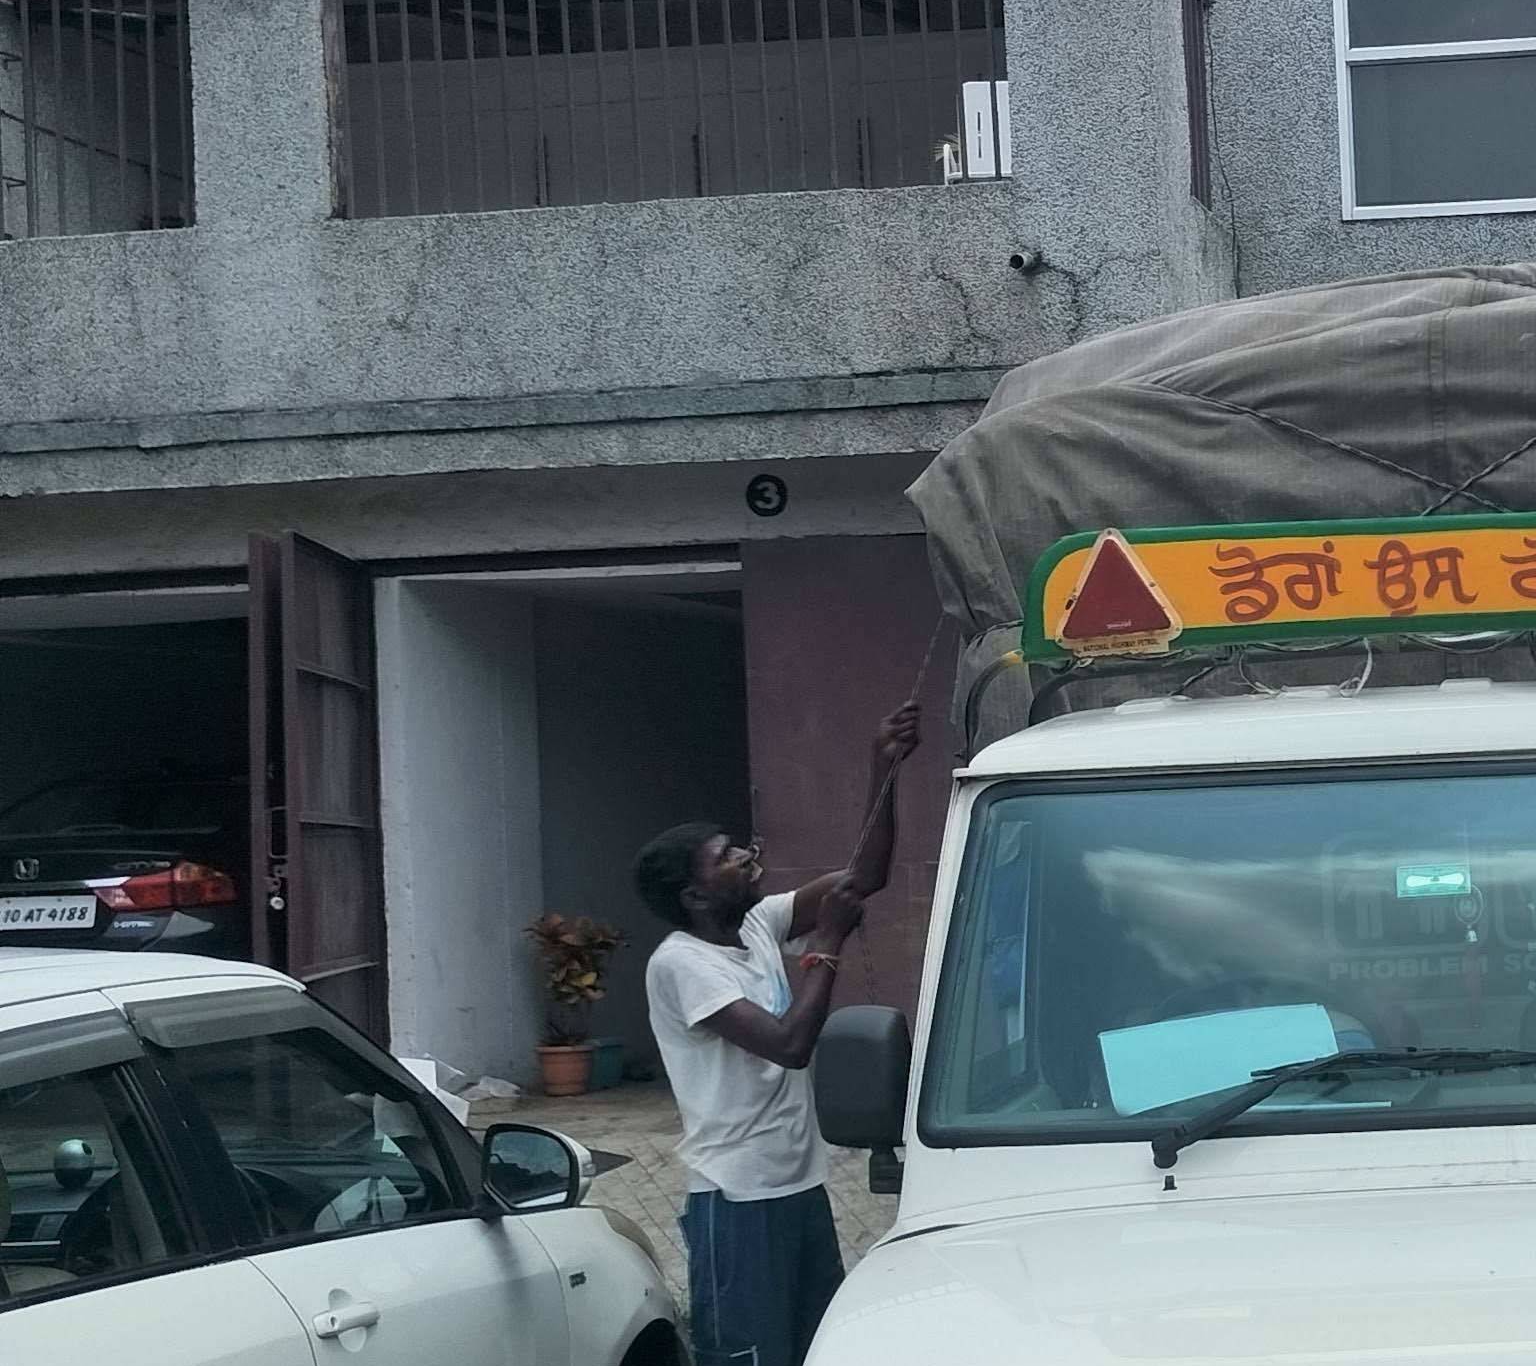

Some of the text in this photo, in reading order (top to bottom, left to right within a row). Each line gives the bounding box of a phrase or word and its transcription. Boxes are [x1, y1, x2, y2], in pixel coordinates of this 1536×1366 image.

[755, 481, 781, 510] 3
[4, 906, 89, 924] 10 AT 4188
[1329, 953, 1489, 981] PROBLEM
